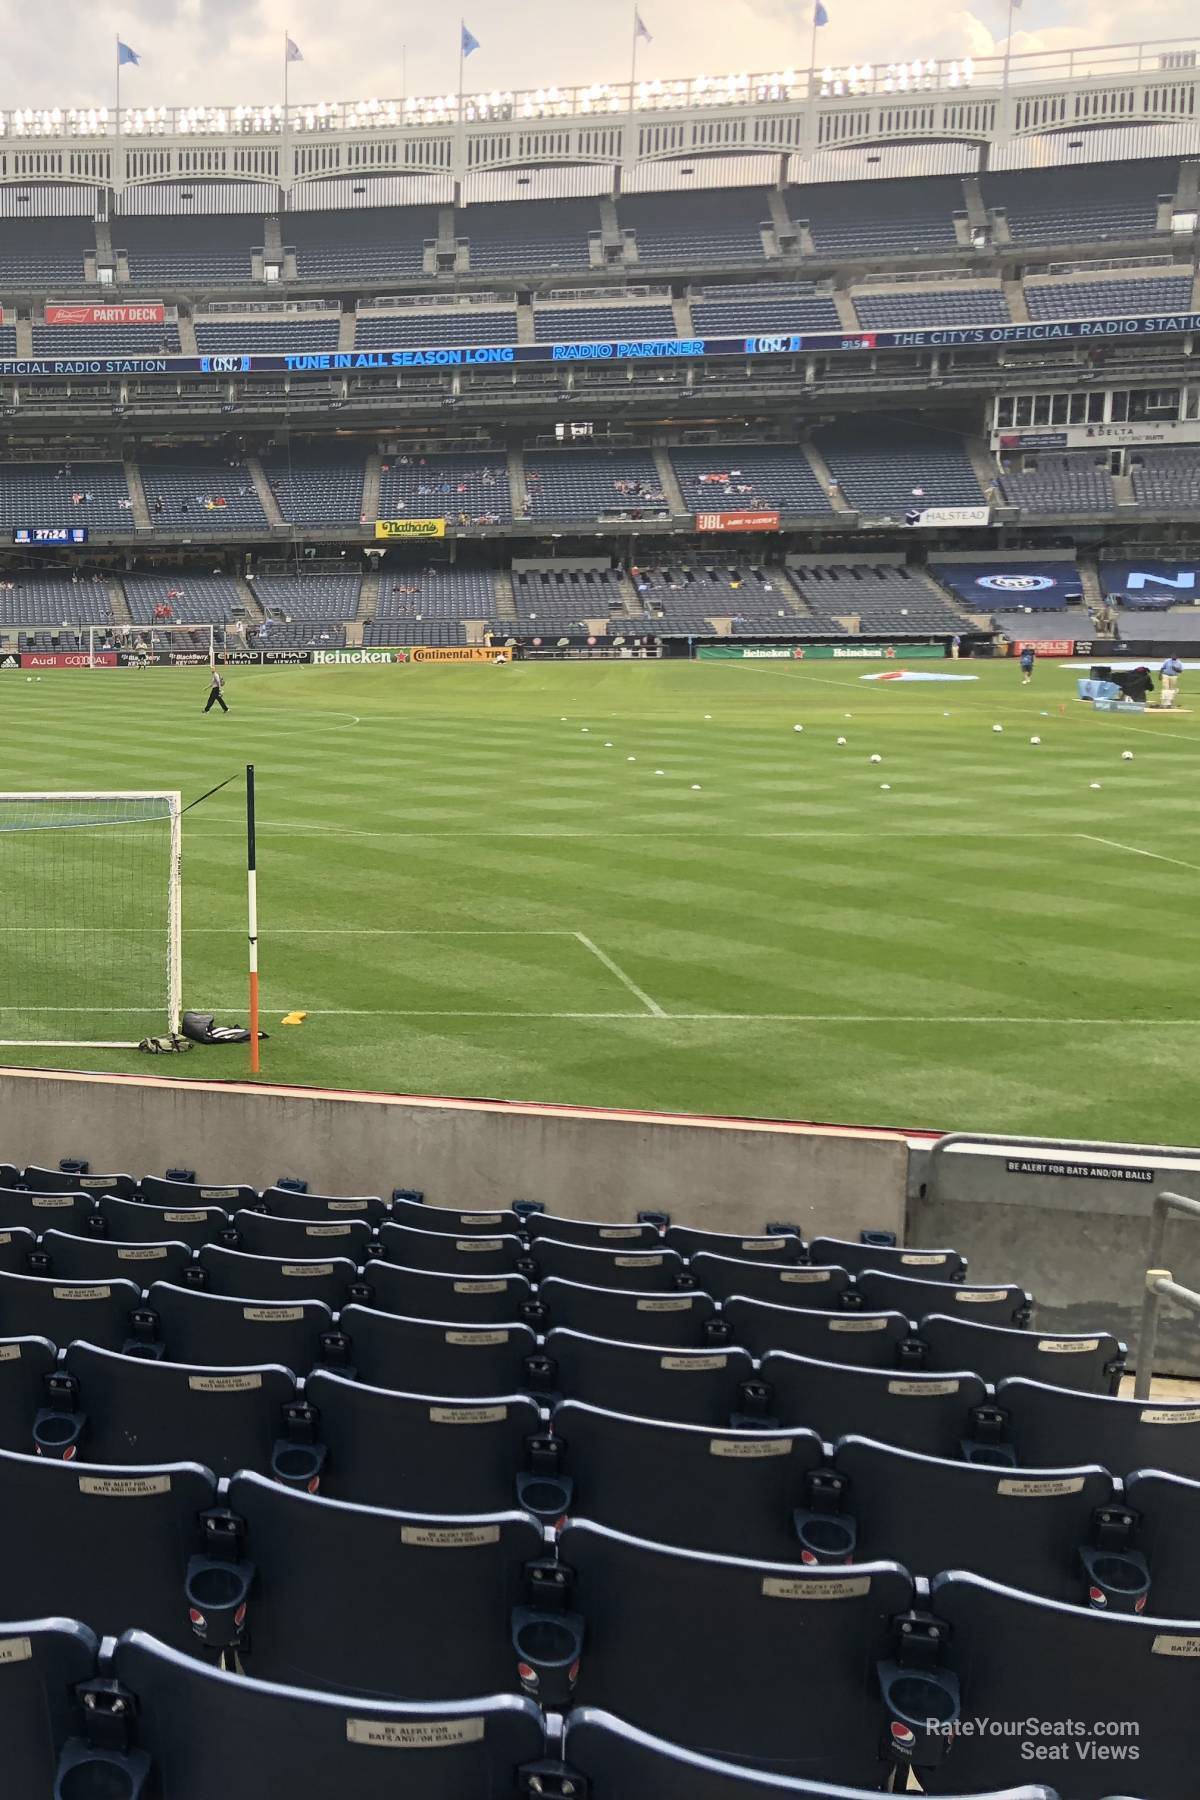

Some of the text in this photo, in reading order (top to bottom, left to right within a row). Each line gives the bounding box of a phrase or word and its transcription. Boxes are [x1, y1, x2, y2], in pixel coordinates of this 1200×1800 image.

[93, 309, 126, 320] PARTY
[129, 309, 157, 320] DECK
[892, 333, 925, 345] THE
[931, 330, 984, 344] CITY'S
[990, 325, 1073, 341] OFFICIAL
[1080, 320, 1138, 335] RADIO
[552, 340, 705, 360] RADIO PARTNER
[285, 348, 513, 370] TUNE IN ALL SEASON LONG
[55, 362, 100, 373] RADIO
[106, 360, 166, 372] STATION
[1098, 428, 1134, 437] DELTA
[703, 514, 725, 529] JBL
[927, 511, 985, 521] HALSTEAD
[382, 521, 437, 533] Nathan's
[36, 530, 66, 539] 27:24
[1126, 572, 1195, 588] N
[217, 652, 258, 660] ETIHAD
[312, 650, 392, 664] Heineken
[413, 649, 473, 662] Continental
[743, 649, 791, 658] Heineken
[833, 648, 882, 657] Heineken
[31, 657, 57, 665] Audi
[1008, 1162, 1152, 1181] BE ALERT FOR BATS AND/OR BALLS
[368, 1733, 392, 1741] BATS
[435, 1732, 463, 1741] BALLS
[400, 1727, 427, 1735] ALERT
